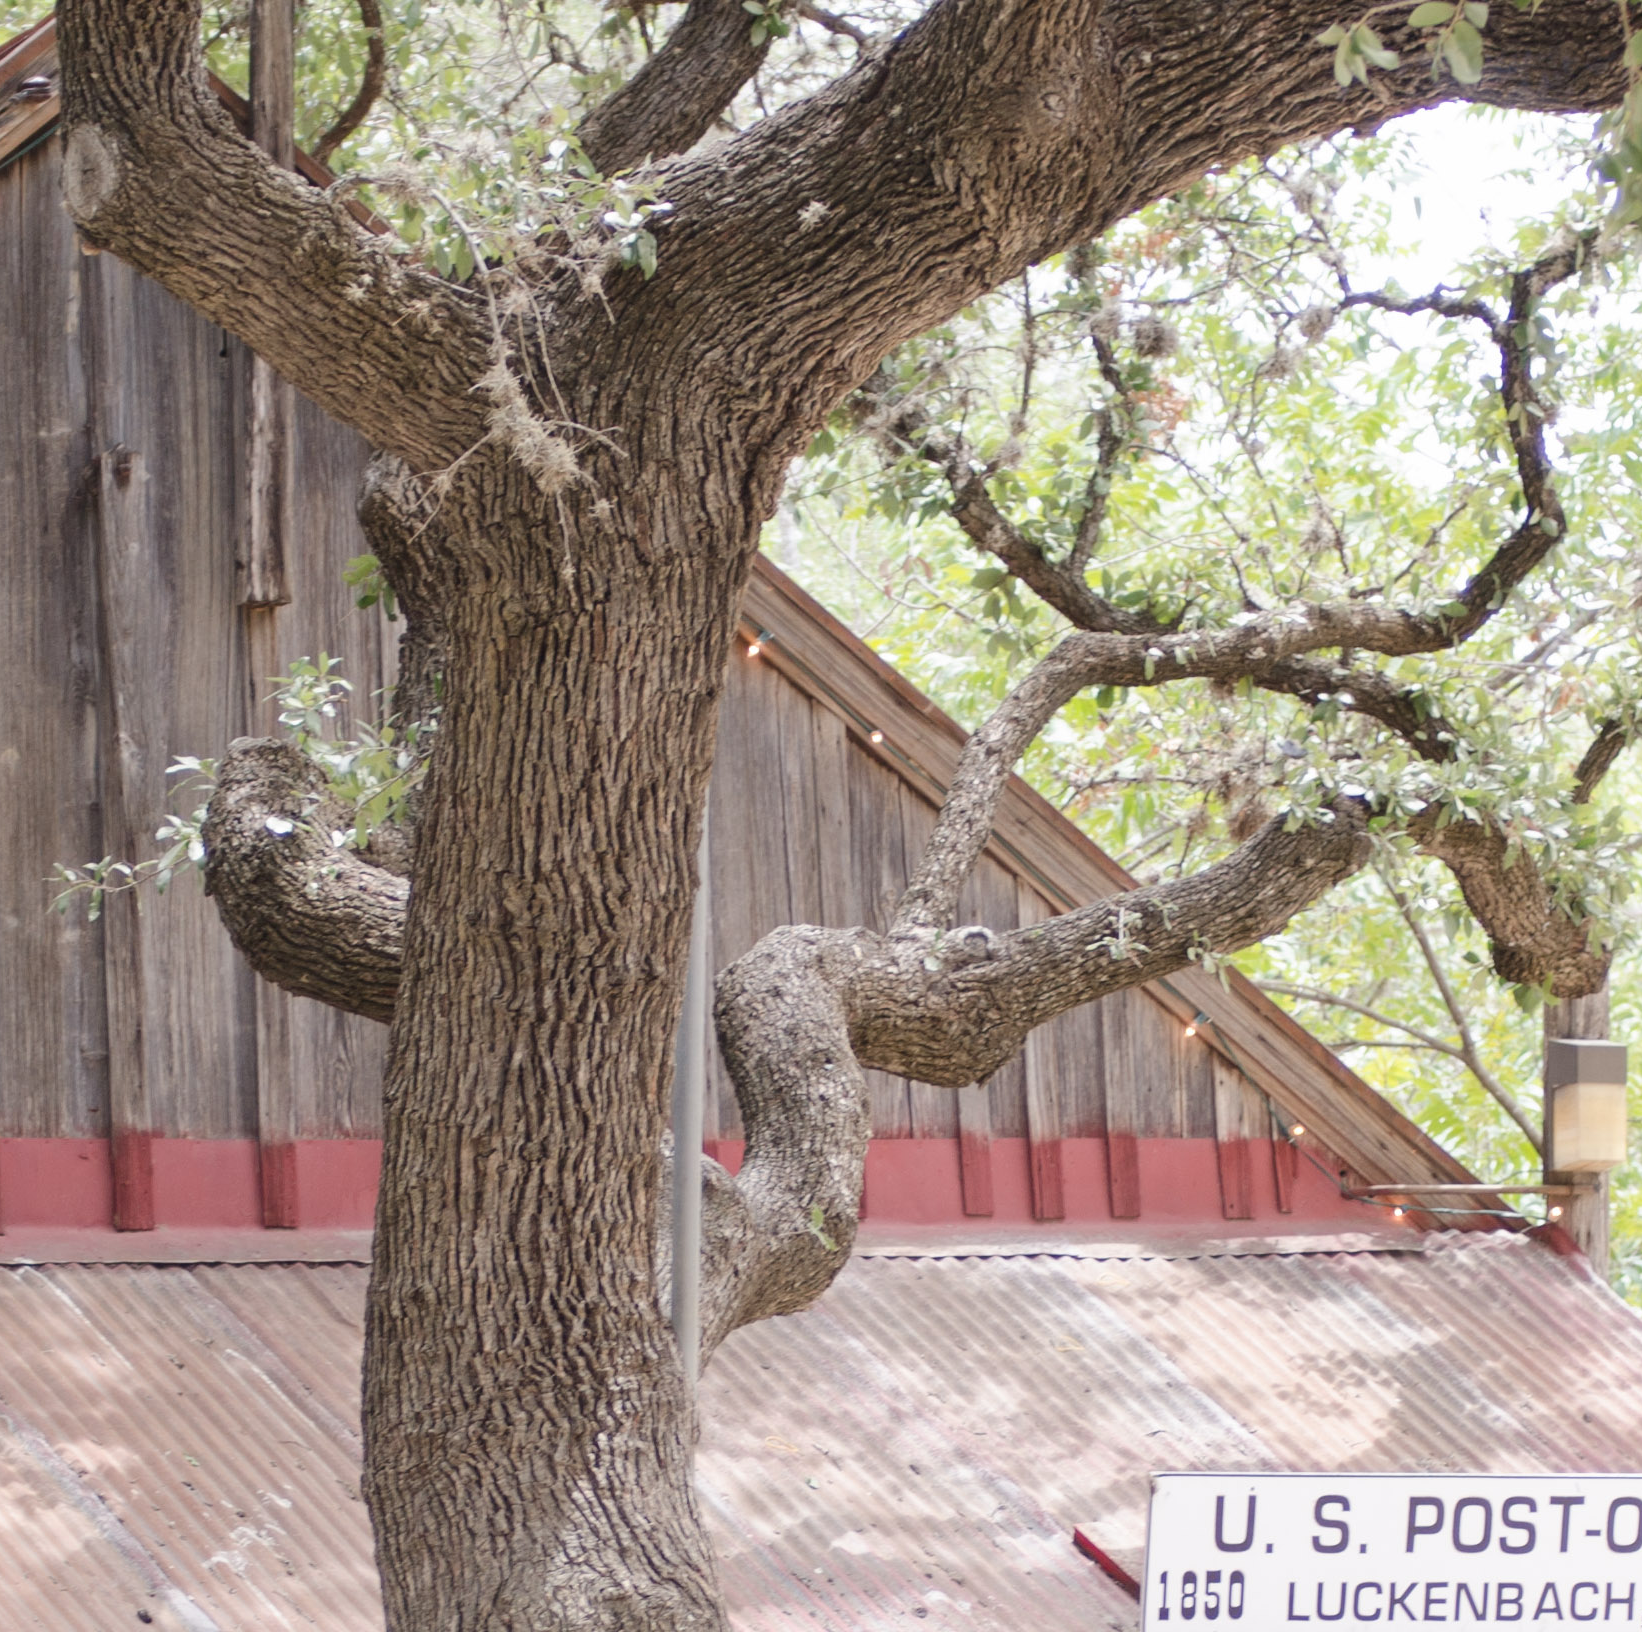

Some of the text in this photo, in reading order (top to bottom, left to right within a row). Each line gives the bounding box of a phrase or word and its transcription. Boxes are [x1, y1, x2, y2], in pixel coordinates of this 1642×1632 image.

[1214, 1495, 1275, 1554] U.
[1312, 1494, 1368, 1555] S.
[1156, 1568, 1246, 1621] 1850
